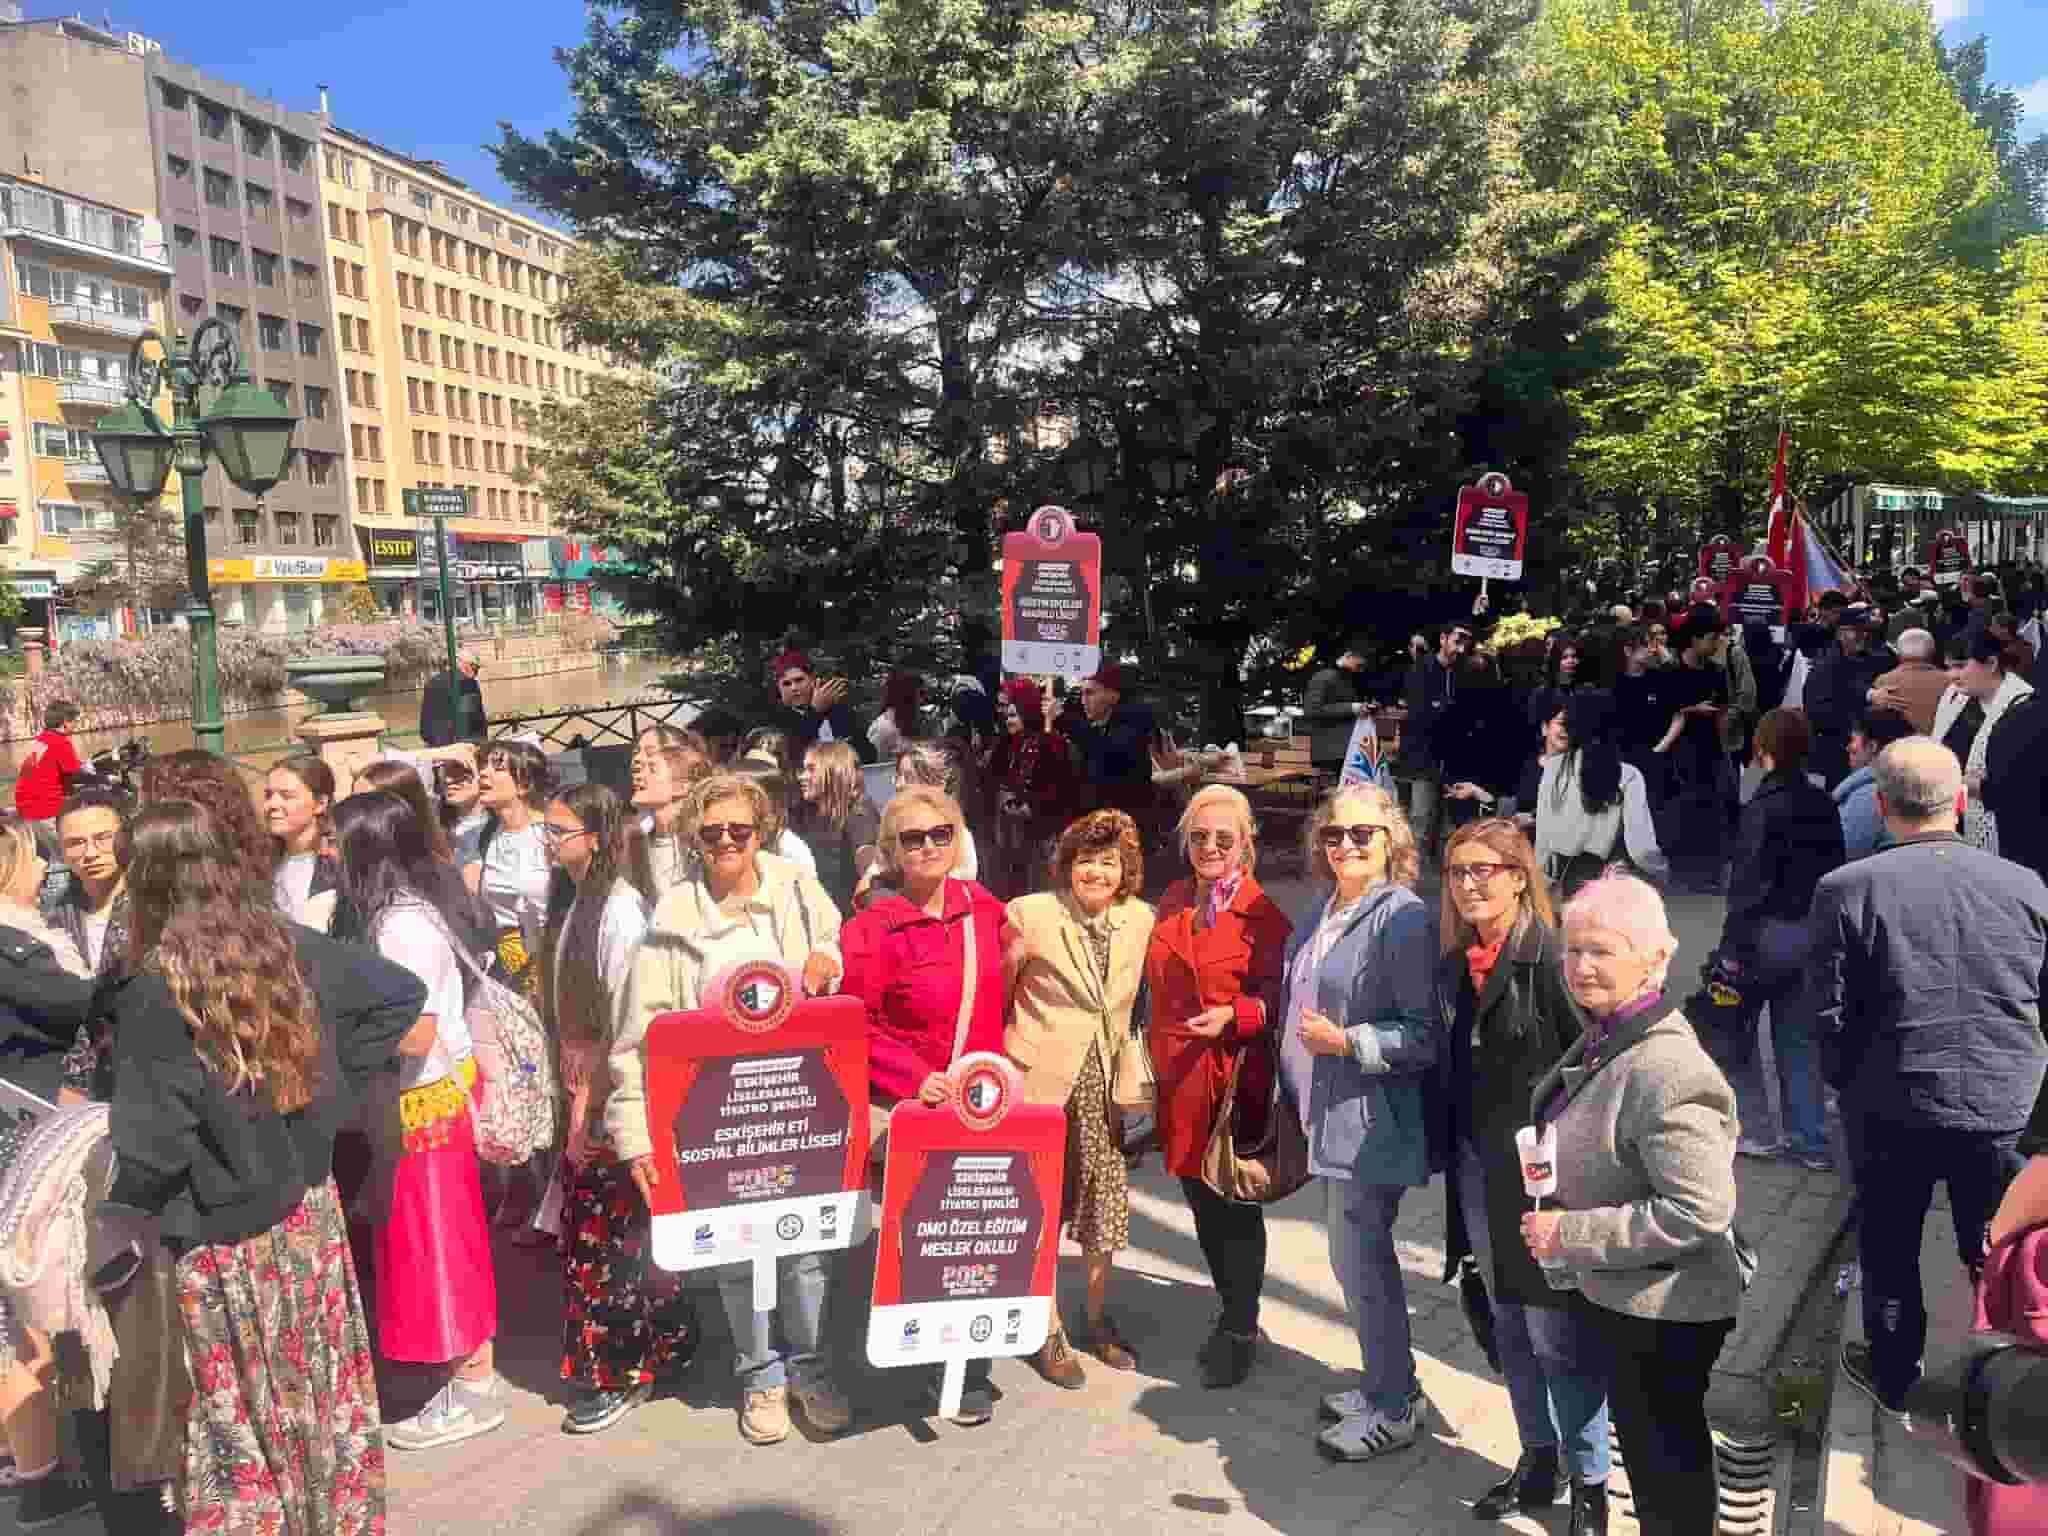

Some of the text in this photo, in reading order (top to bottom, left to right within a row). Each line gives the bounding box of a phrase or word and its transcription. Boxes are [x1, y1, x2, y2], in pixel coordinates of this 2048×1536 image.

[714, 1116, 809, 1143] ESKİŞEHİR ETİ
[680, 1129, 842, 1164] SOSYAL BİLİMLER LİSESİ
[950, 1217, 983, 1236] ÖZEL
[984, 1216, 1028, 1235] EĞİTİM
[919, 1239, 1018, 1257] MESLEK OKULU
